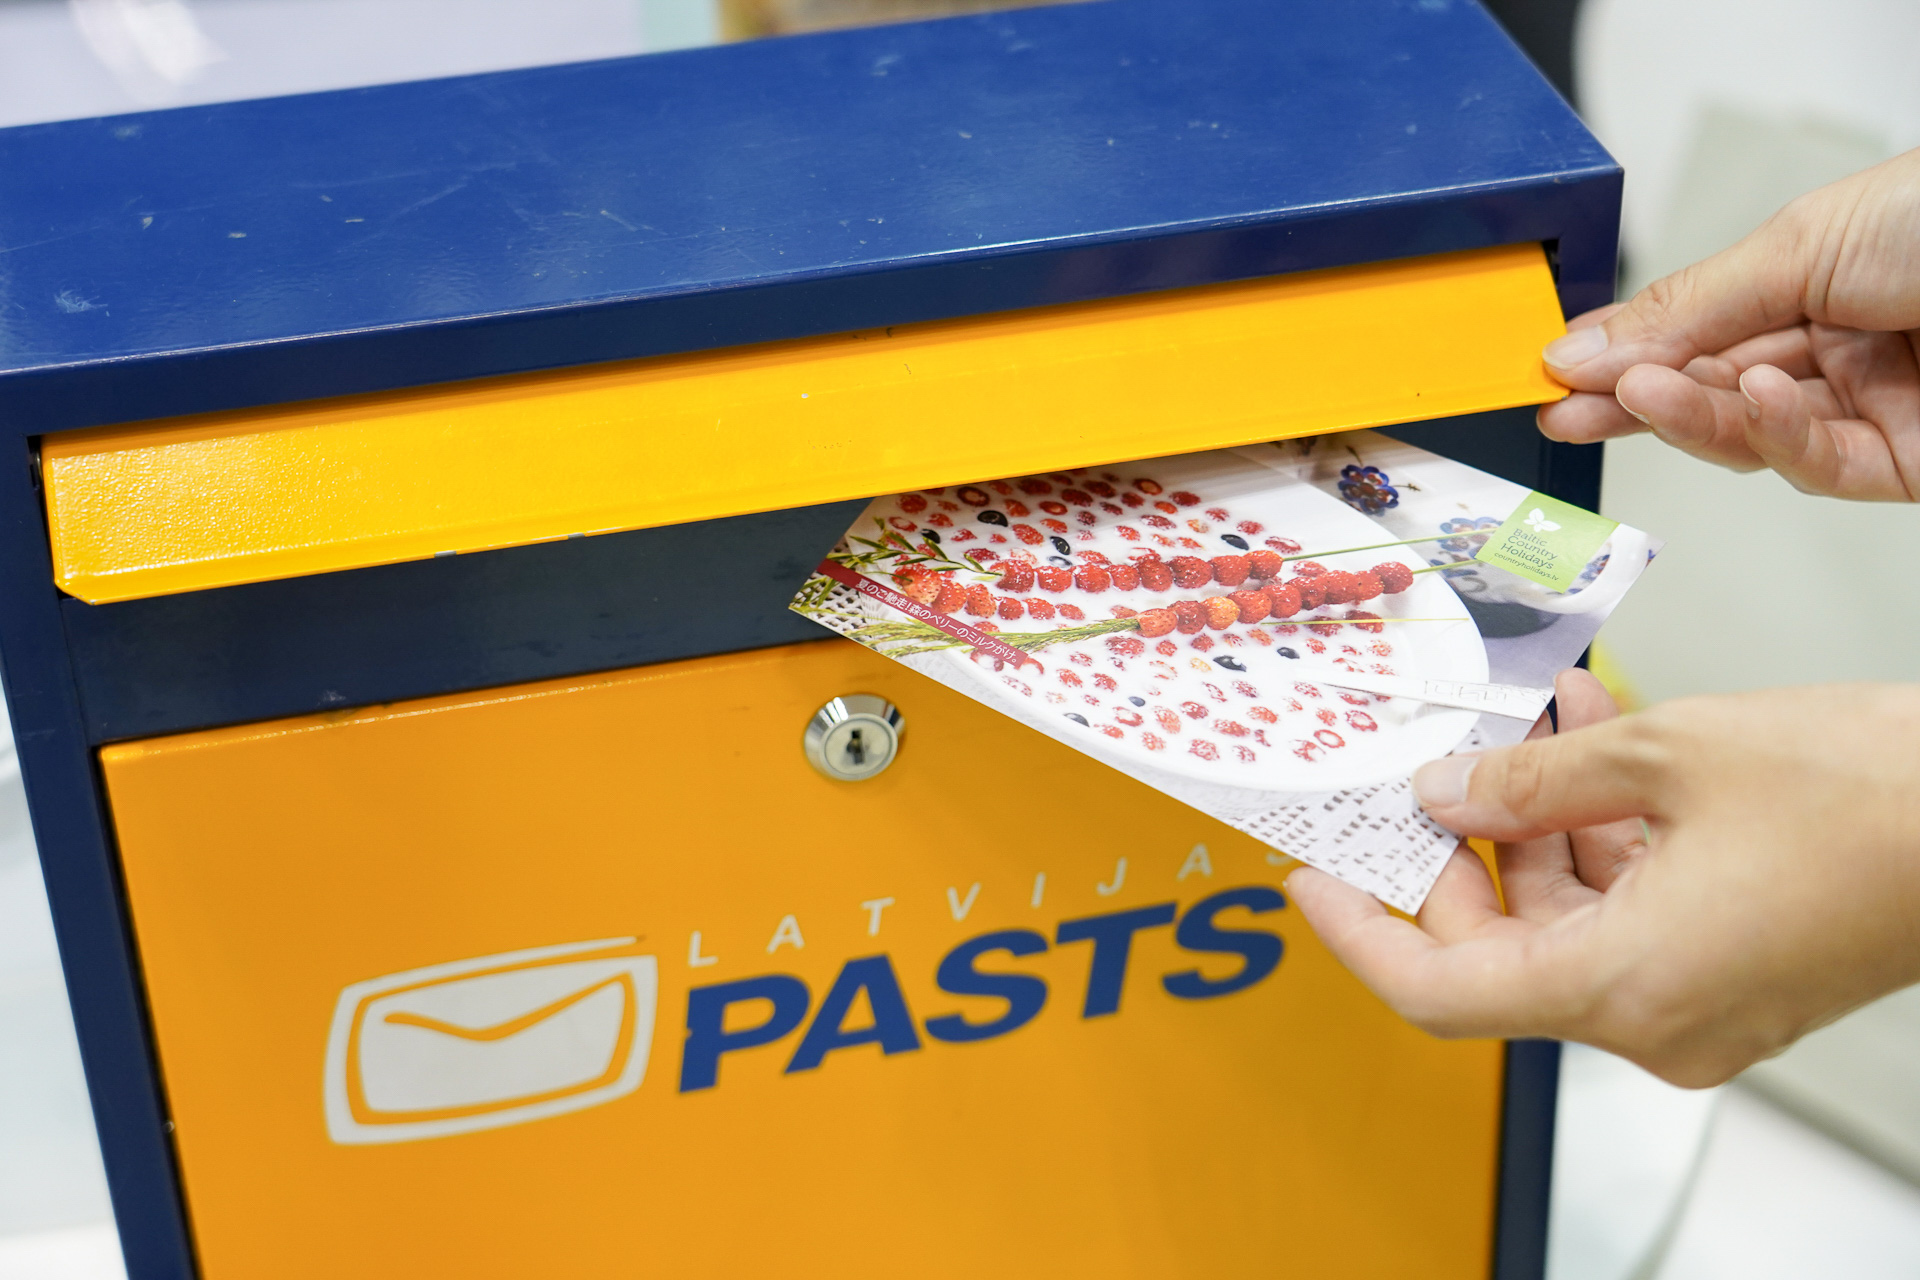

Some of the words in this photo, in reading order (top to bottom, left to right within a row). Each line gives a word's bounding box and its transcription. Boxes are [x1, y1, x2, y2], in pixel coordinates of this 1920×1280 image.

[1507, 535, 1558, 561] Country
[1513, 528, 1548, 547] Baltic
[1494, 552, 1559, 581] countryholidays.lv
[1500, 543, 1554, 570] Holidays
[679, 885, 1288, 1094] PASTS
